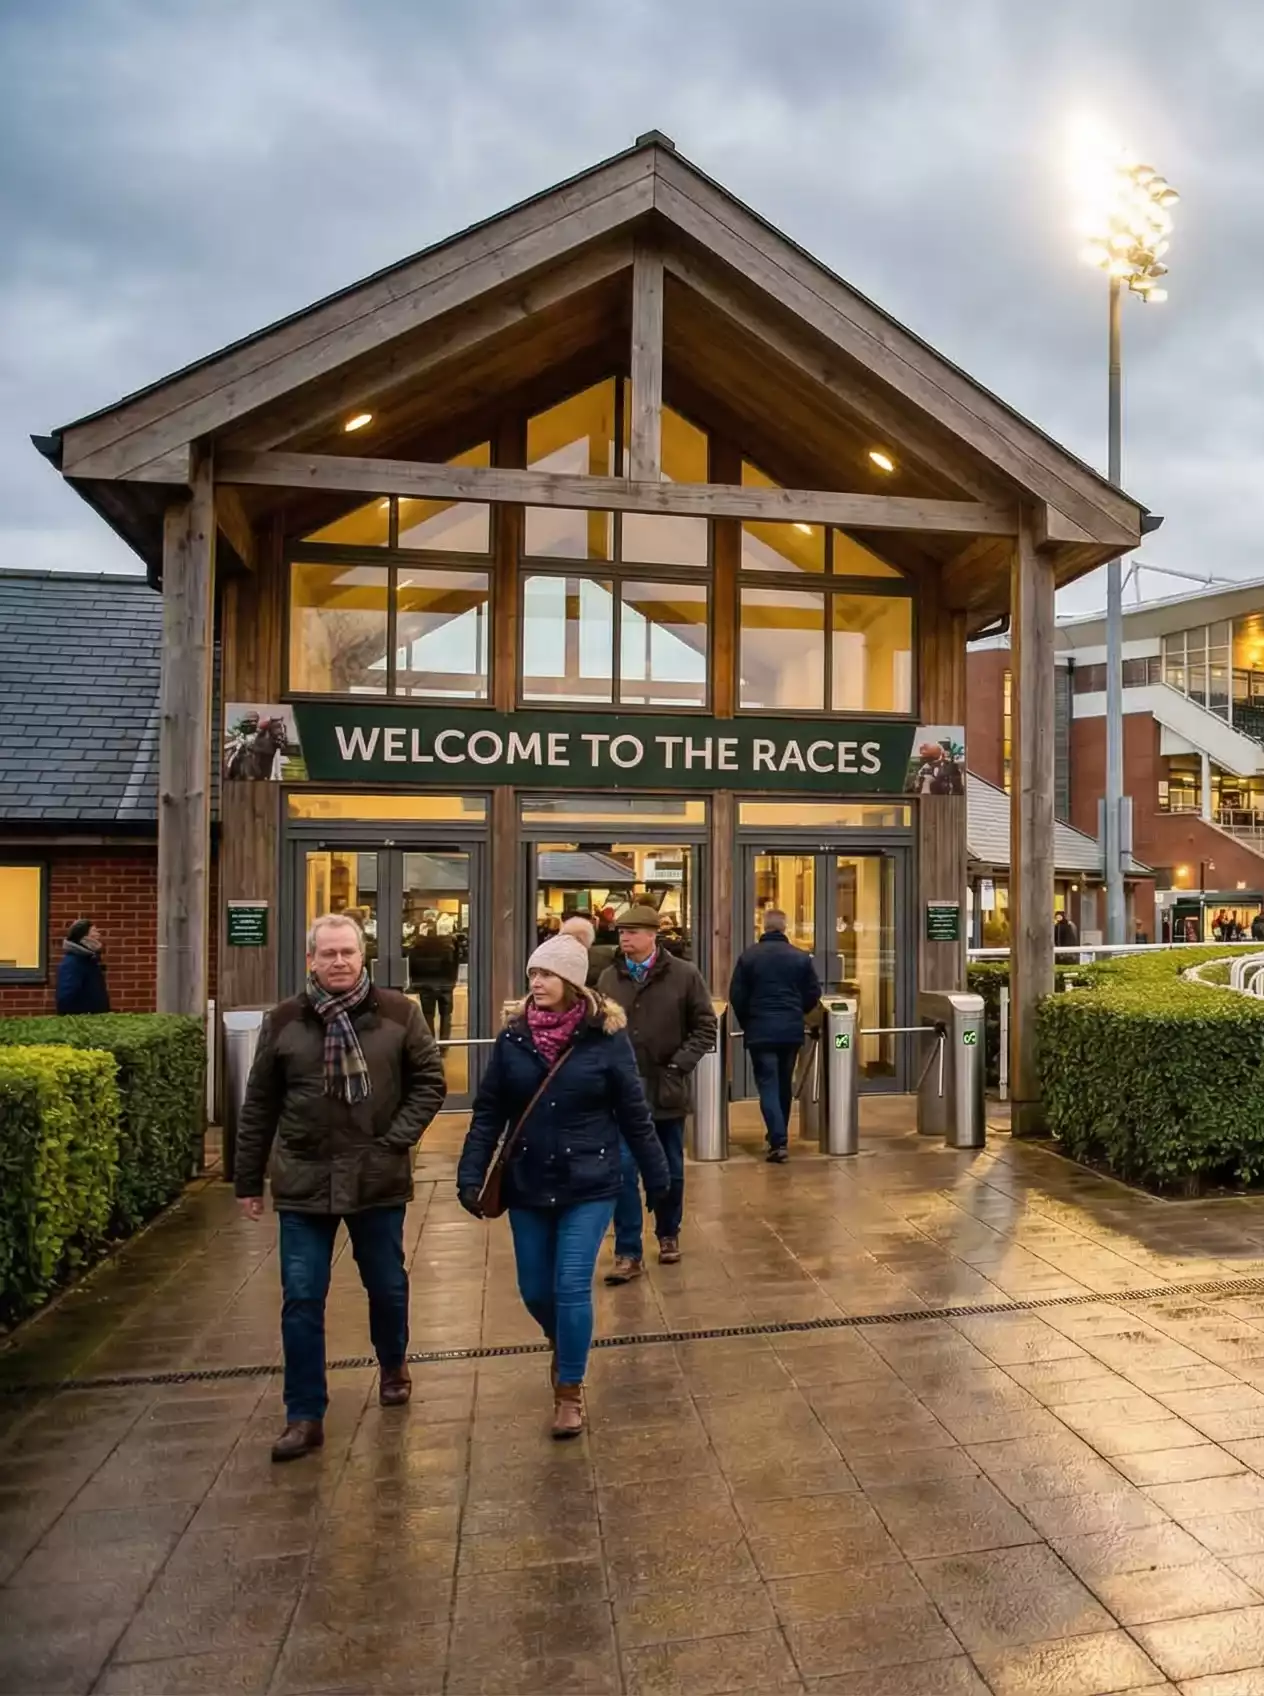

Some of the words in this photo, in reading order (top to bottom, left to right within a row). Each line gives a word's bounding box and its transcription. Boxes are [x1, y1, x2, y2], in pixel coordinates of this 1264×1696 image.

[334, 726, 570, 767] WELCOME
[580, 733, 644, 769] TO
[654, 735, 739, 771] THE
[752, 738, 882, 775] RACES
